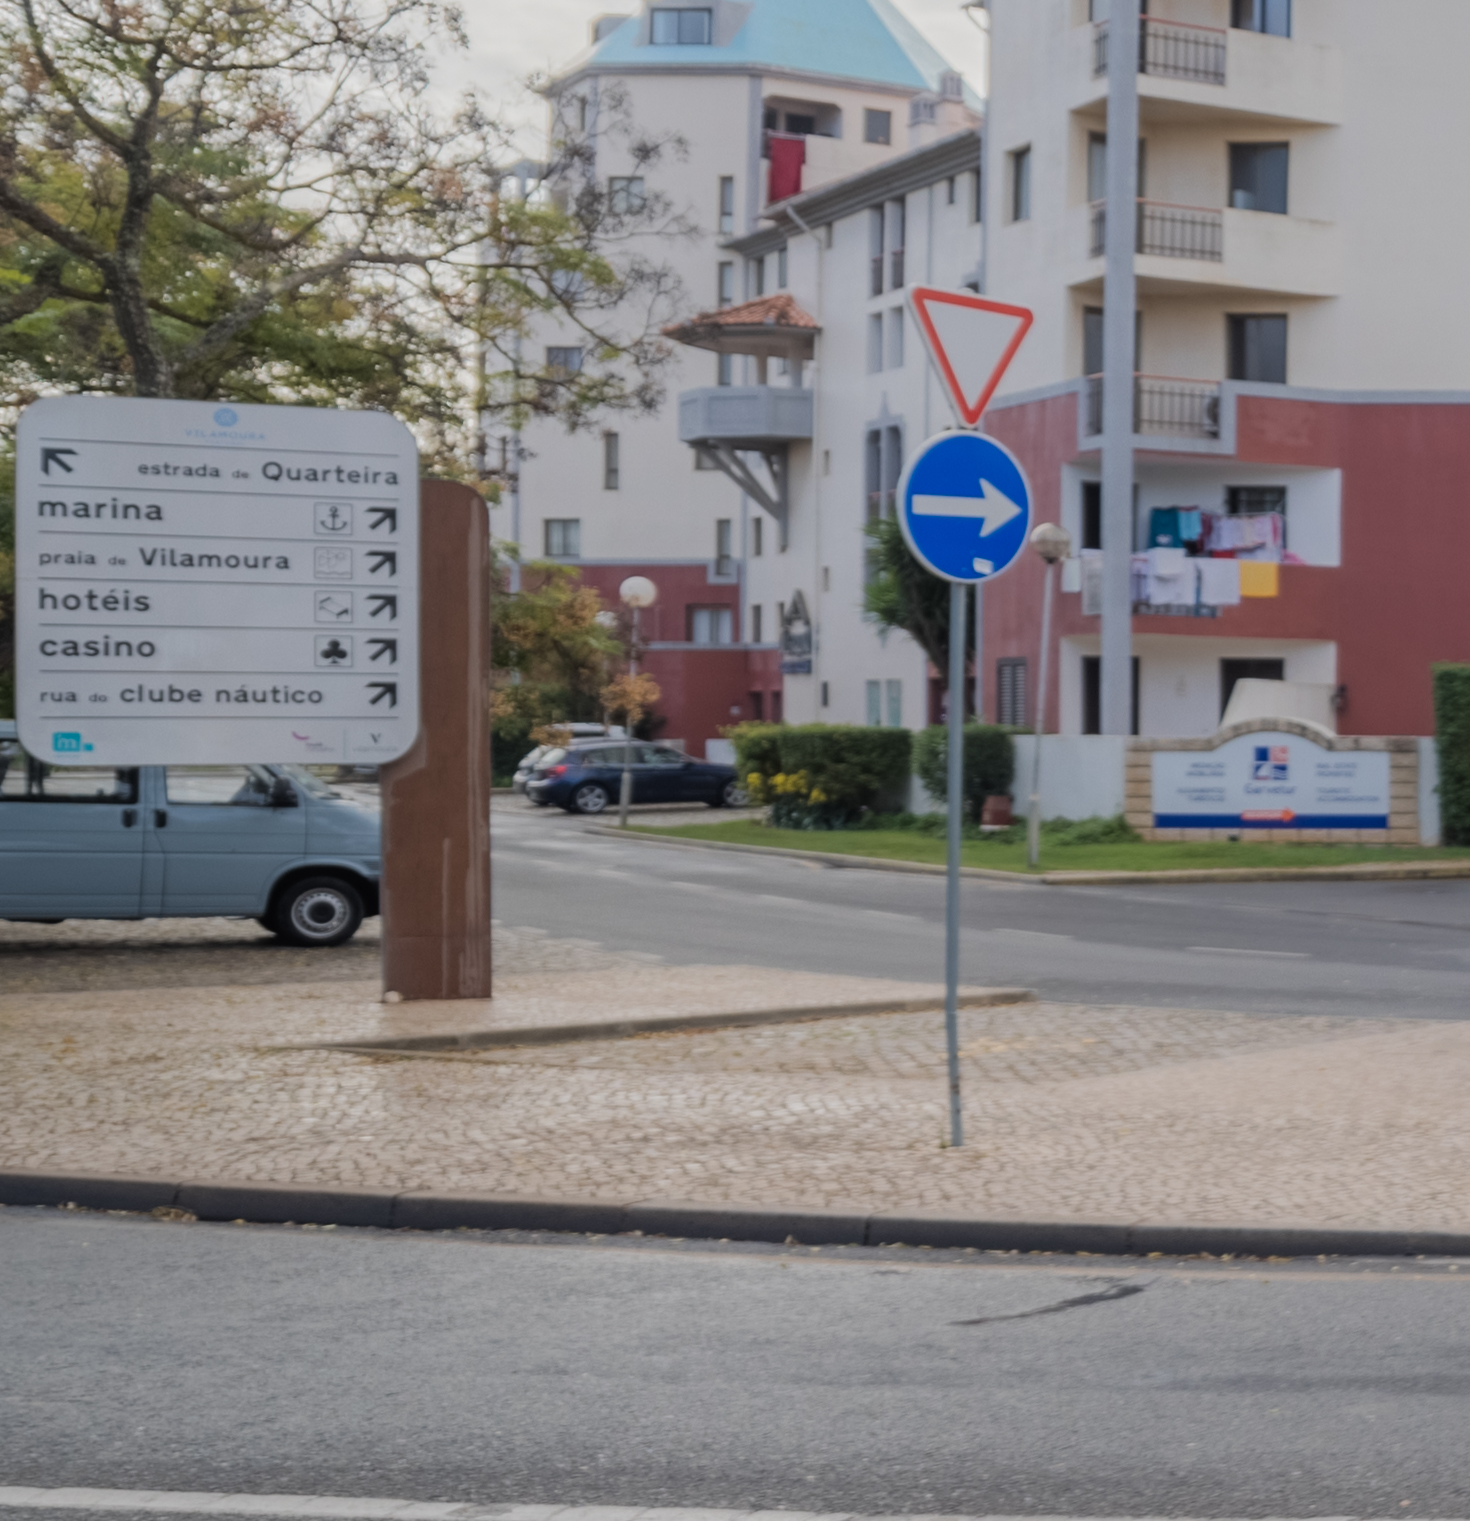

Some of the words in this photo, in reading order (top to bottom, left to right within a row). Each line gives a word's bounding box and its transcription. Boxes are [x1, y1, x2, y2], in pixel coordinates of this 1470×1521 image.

[185, 429, 265, 441] VILAMOURA
[137, 461, 221, 479] estrada
[231, 469, 250, 480] de
[261, 461, 399, 486] Quarteira
[38, 497, 164, 521] marina
[39, 550, 97, 567] praia
[107, 555, 127, 566] de
[139, 547, 290, 570] Vilamoura
[38, 587, 151, 613] hotéis
[39, 634, 156, 658] casino
[39, 690, 78, 704] rua
[88, 692, 108, 703] do
[119, 684, 203, 704] clube
[215, 684, 323, 704] náutico
